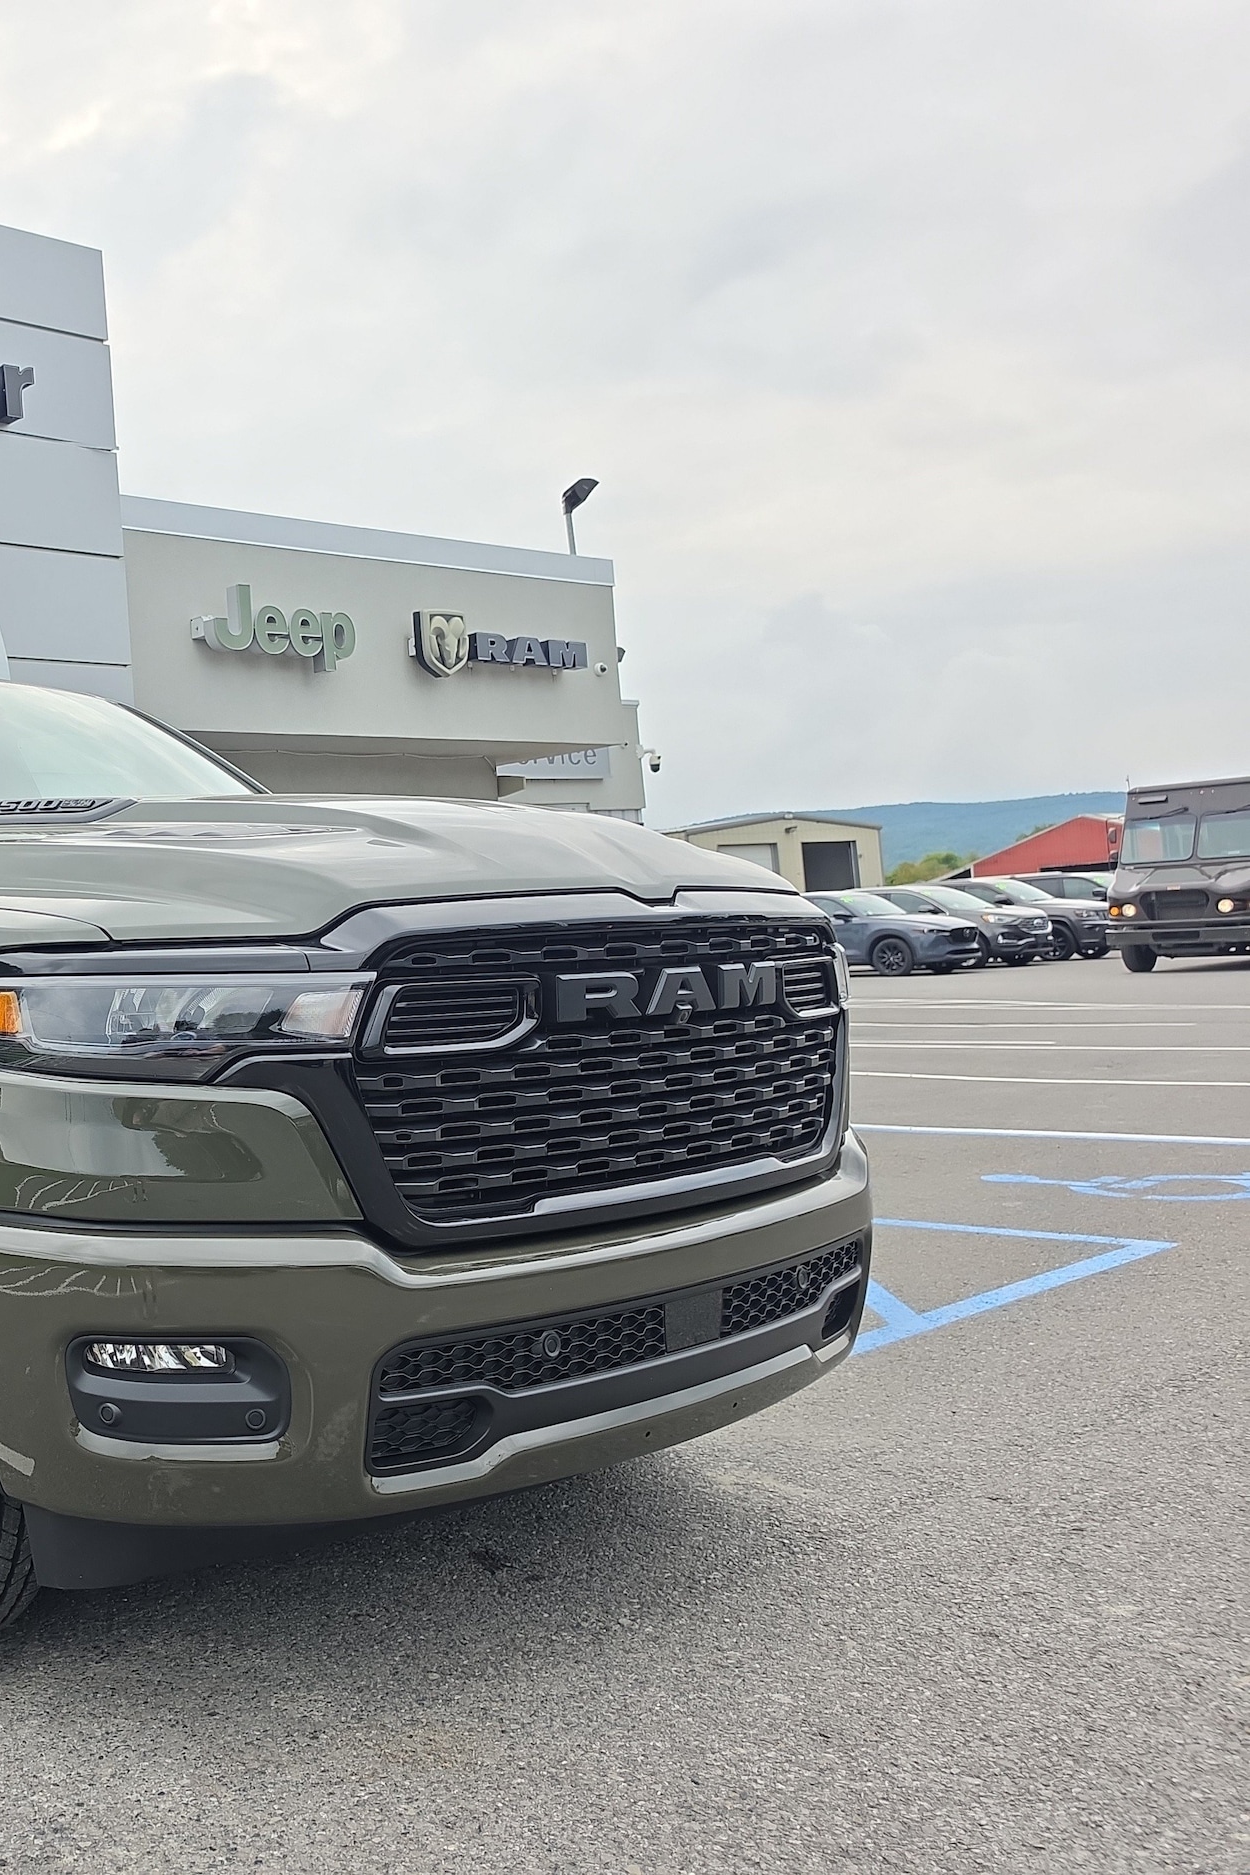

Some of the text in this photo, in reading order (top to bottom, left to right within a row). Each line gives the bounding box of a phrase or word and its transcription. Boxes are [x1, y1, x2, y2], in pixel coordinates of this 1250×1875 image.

[206, 584, 356, 672] Jeep
[472, 632, 588, 670] RAM
[556, 961, 776, 1022] RAM
